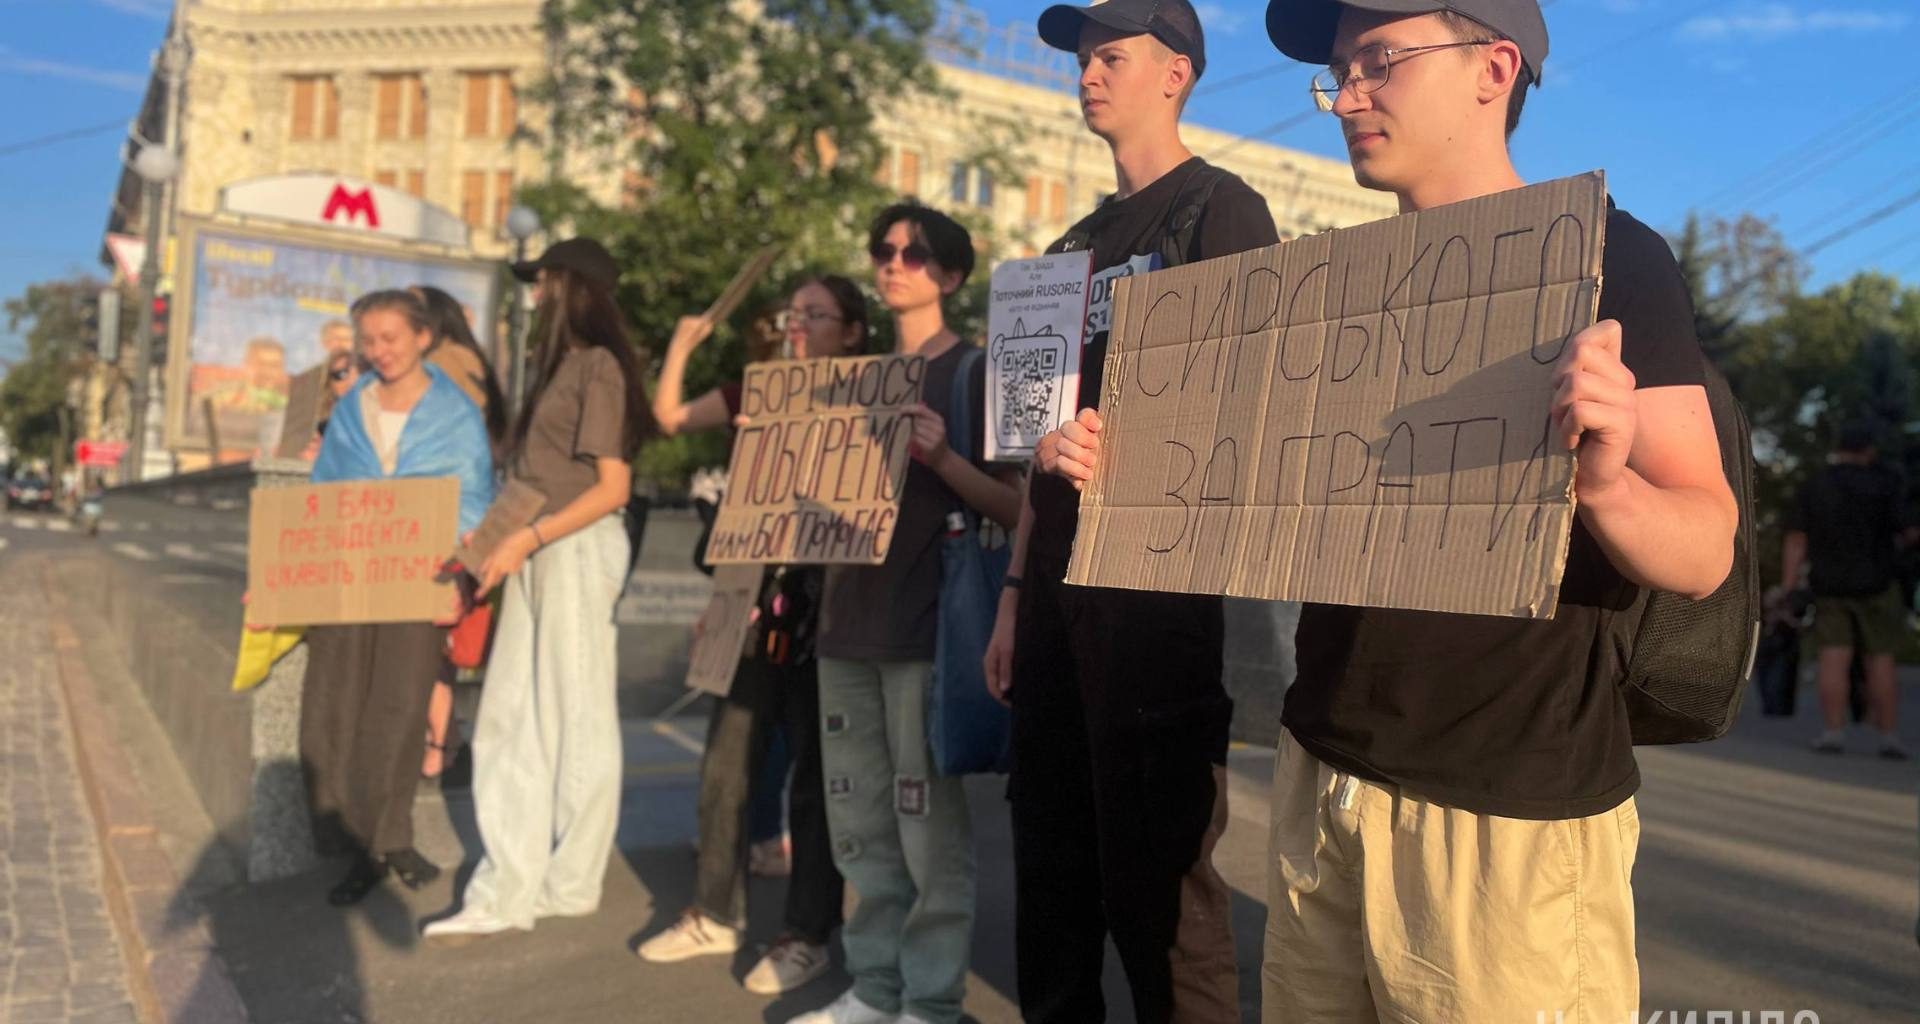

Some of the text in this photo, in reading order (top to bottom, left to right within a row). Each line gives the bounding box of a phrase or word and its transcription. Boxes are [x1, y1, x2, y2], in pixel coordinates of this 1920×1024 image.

[1035, 281, 1083, 298] RUSORIZ
[1137, 213, 1585, 397] СИРСЬКОГО
[726, 412, 916, 507] ПОБОРЕМО
[1146, 412, 1552, 561] ЗА ГРАТИ
[278, 519, 421, 555] ПРЕЗИДЕНТА
[303, 494, 320, 522] Я
